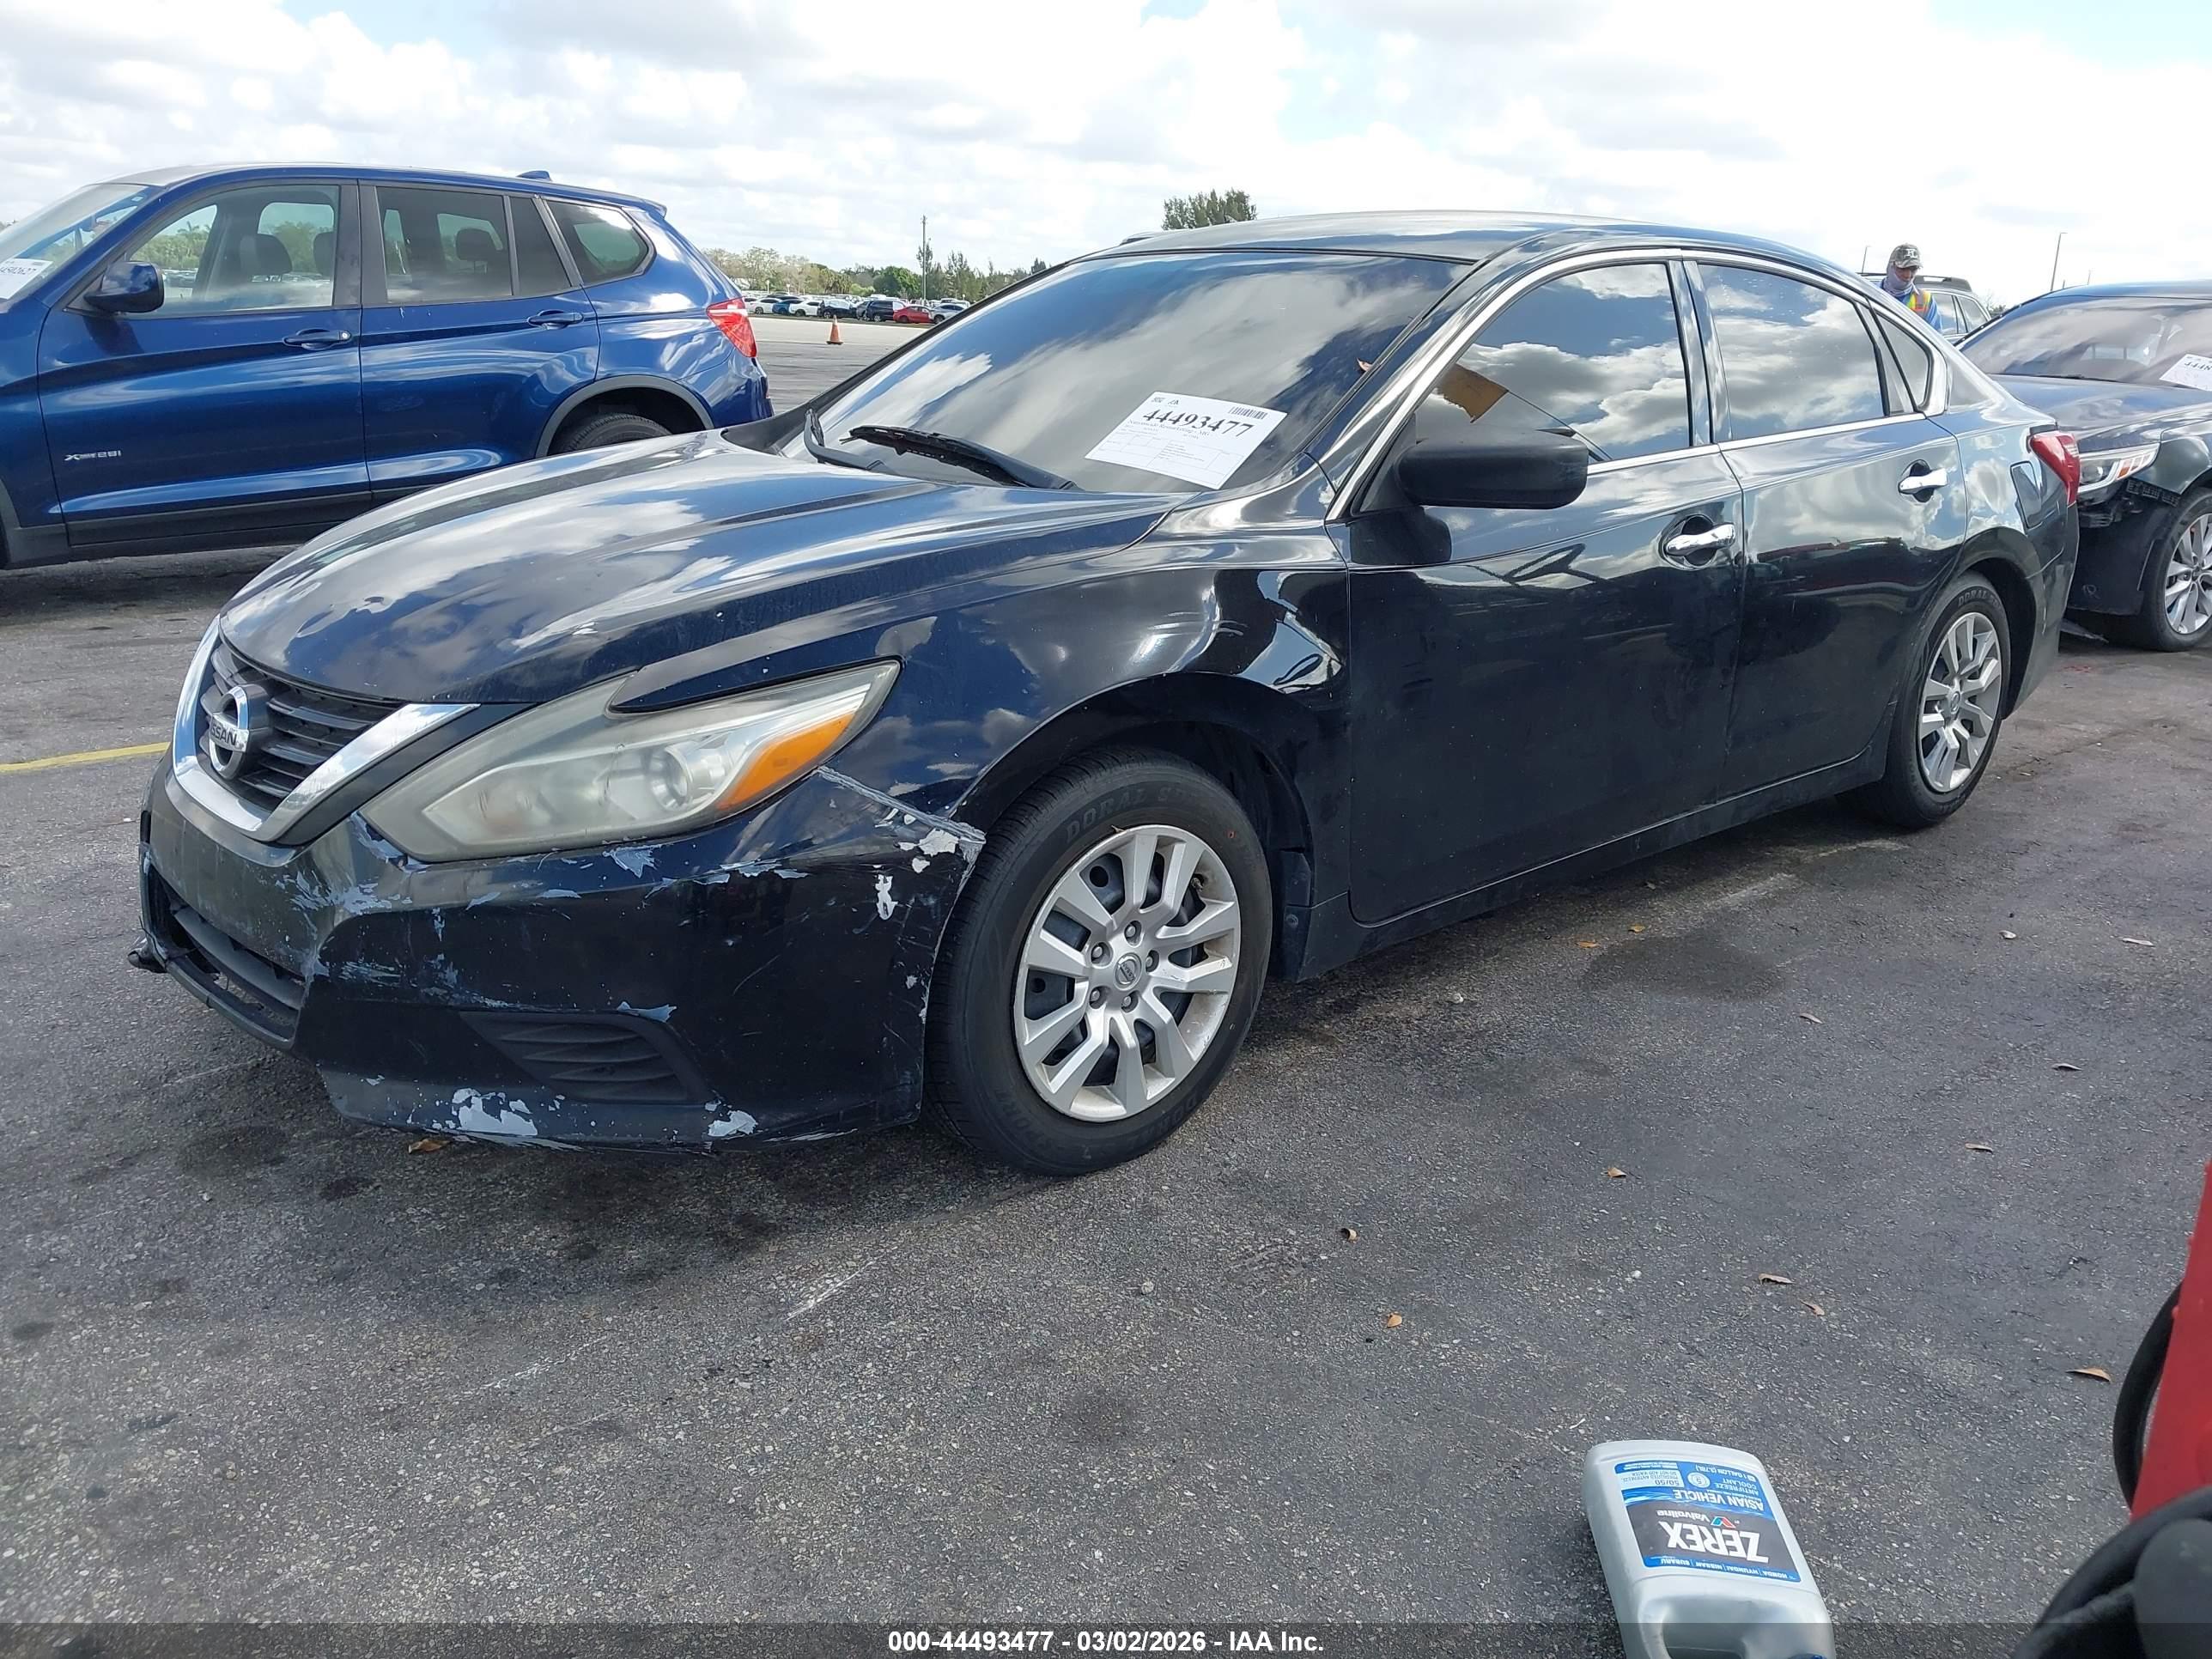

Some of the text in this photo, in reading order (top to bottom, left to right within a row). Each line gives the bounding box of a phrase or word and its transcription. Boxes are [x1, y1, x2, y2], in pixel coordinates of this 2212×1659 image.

[1143, 409, 1255, 437] 44493477
[1958, 589, 1988, 606] DORAL
[1065, 787, 1148, 843] DORAL
[1717, 1468, 1743, 1479] GALLON
[1714, 1482, 1759, 1496] ANTIFREEZE
[1723, 1478, 1757, 1490] COOLANT
[1673, 1489, 1727, 1504] VEHICLE
[1727, 1495, 1764, 1511] ASIAN
[1656, 1510, 1711, 1522] Valvoline
[1658, 1521, 1769, 1564] ZEREX
[1661, 1558, 1691, 1566] SUBARU
[1695, 1561, 1723, 1571] NISSAN
[1726, 1565, 1759, 1576] HYUNDAI
[1763, 1571, 1787, 1579] HONDA
